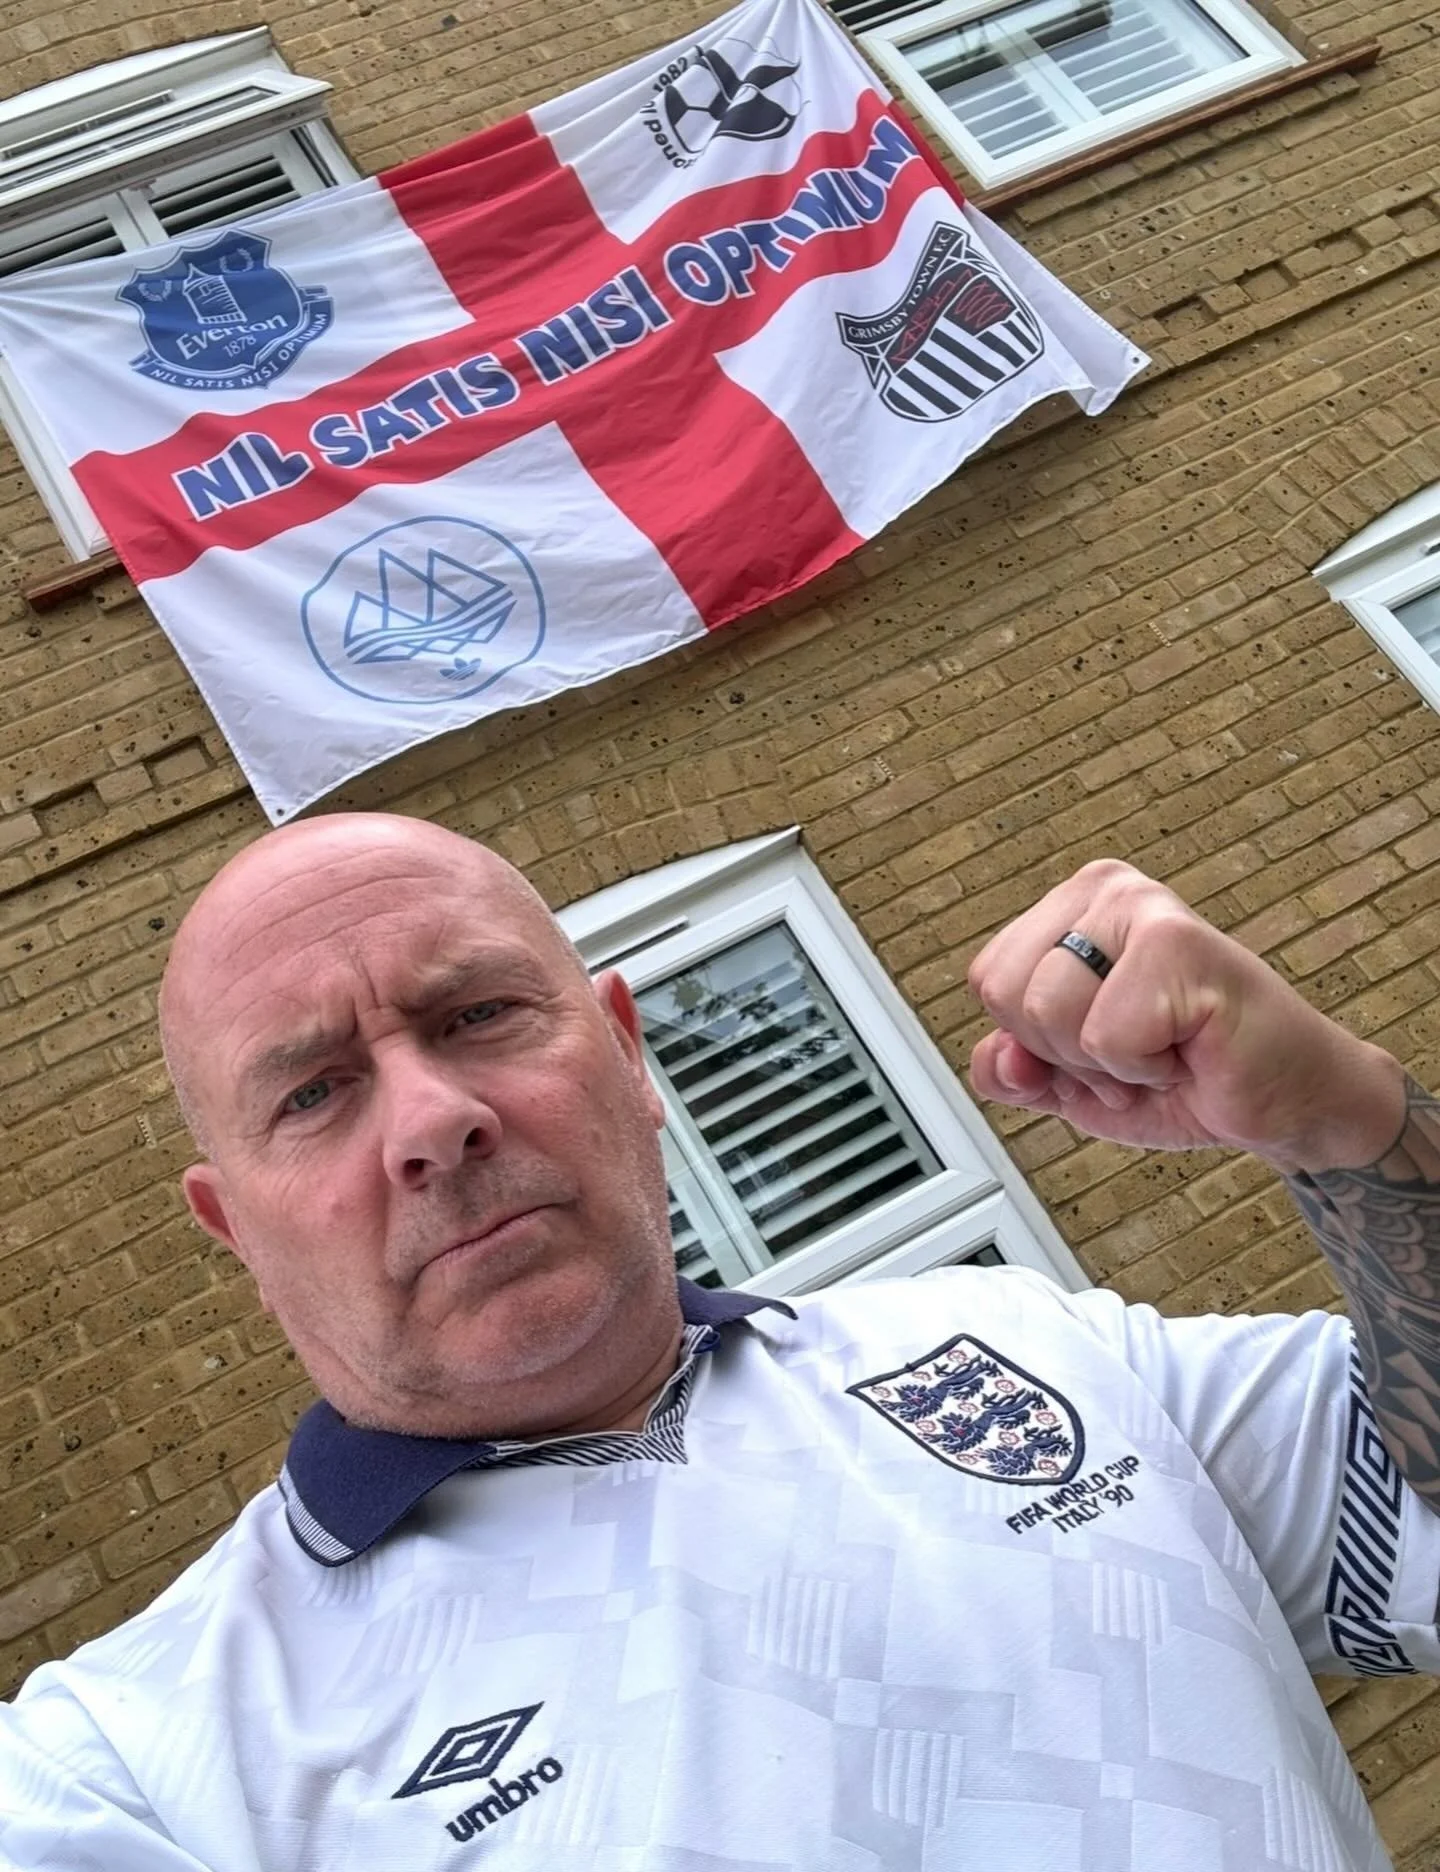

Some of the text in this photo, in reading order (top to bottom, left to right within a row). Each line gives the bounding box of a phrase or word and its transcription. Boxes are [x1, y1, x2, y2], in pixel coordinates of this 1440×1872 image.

[652, 57, 688, 92] 1982
[171, 114, 922, 522] NIL SATIS NISI OPTIMUM
[848, 311, 909, 338] GRIMSBY
[908, 257, 937, 305] TOWN
[150, 313, 327, 389] NIL SATIS NISI OPTIMUM
[176, 314, 288, 360] Everton
[223, 335, 257, 358] 1878
[1005, 1455, 1140, 1534] FIFA WORLD CUP
[1052, 1484, 1134, 1534] ITALY '90
[444, 1757, 563, 1842] umbro
